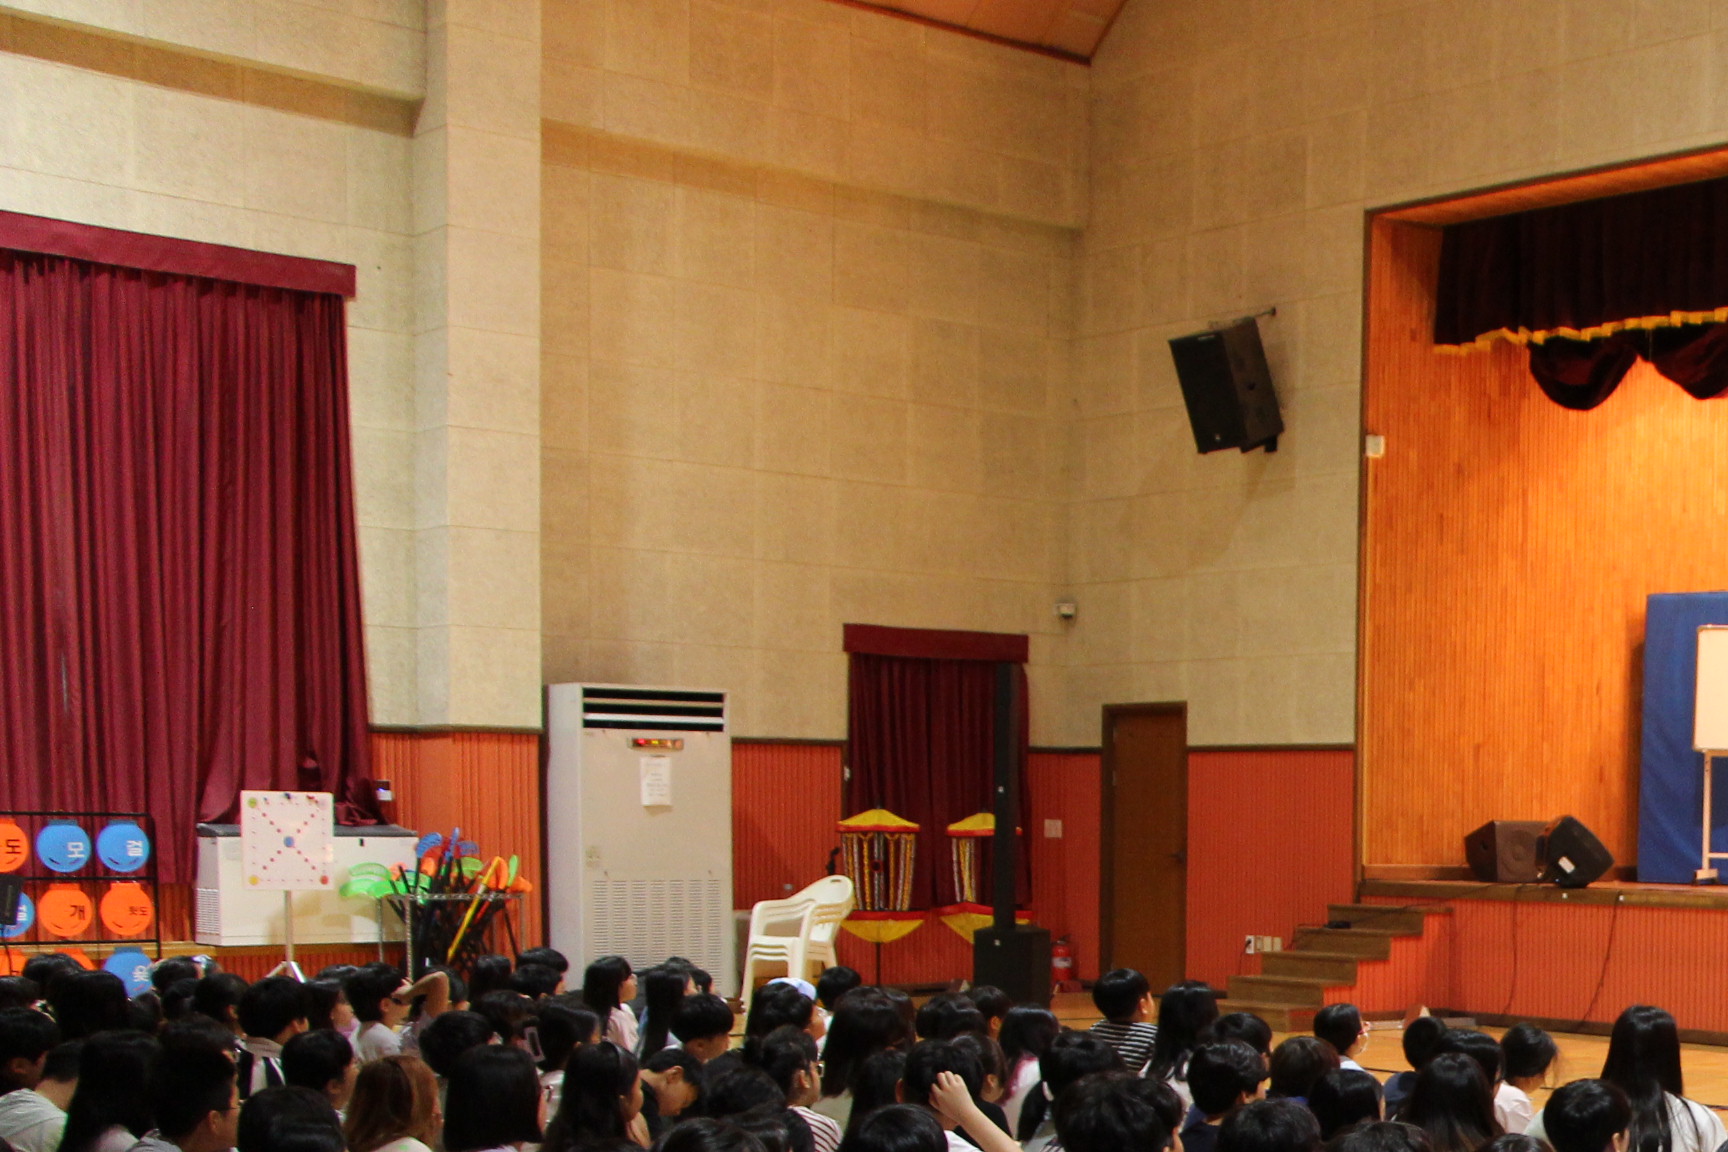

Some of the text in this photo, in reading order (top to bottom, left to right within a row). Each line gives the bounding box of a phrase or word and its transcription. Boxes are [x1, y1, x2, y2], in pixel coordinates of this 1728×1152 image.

[6, 839, 22, 855] 도
[67, 841, 86, 858] 모
[70, 904, 86, 921] 개
